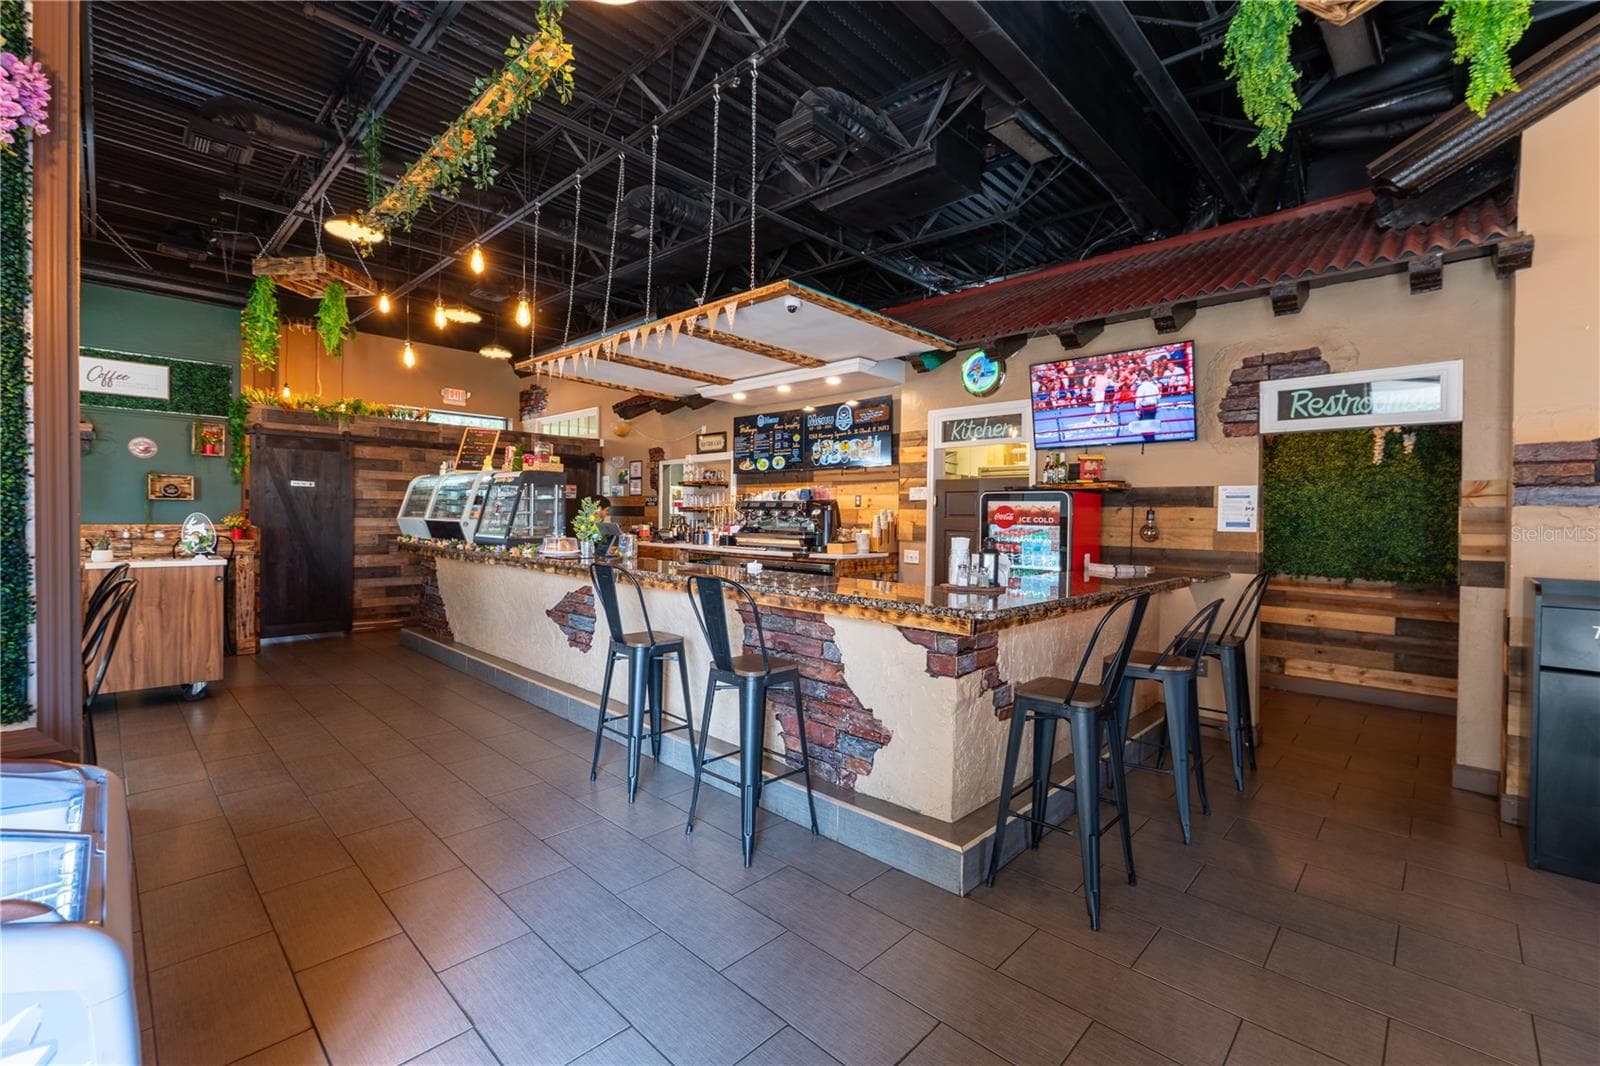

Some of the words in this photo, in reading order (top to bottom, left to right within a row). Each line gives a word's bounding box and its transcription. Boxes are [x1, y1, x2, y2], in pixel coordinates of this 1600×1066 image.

[86, 365, 130, 388] Coffee
[1290, 388, 1416, 418] Restro
[951, 418, 1017, 440] Kitchen
